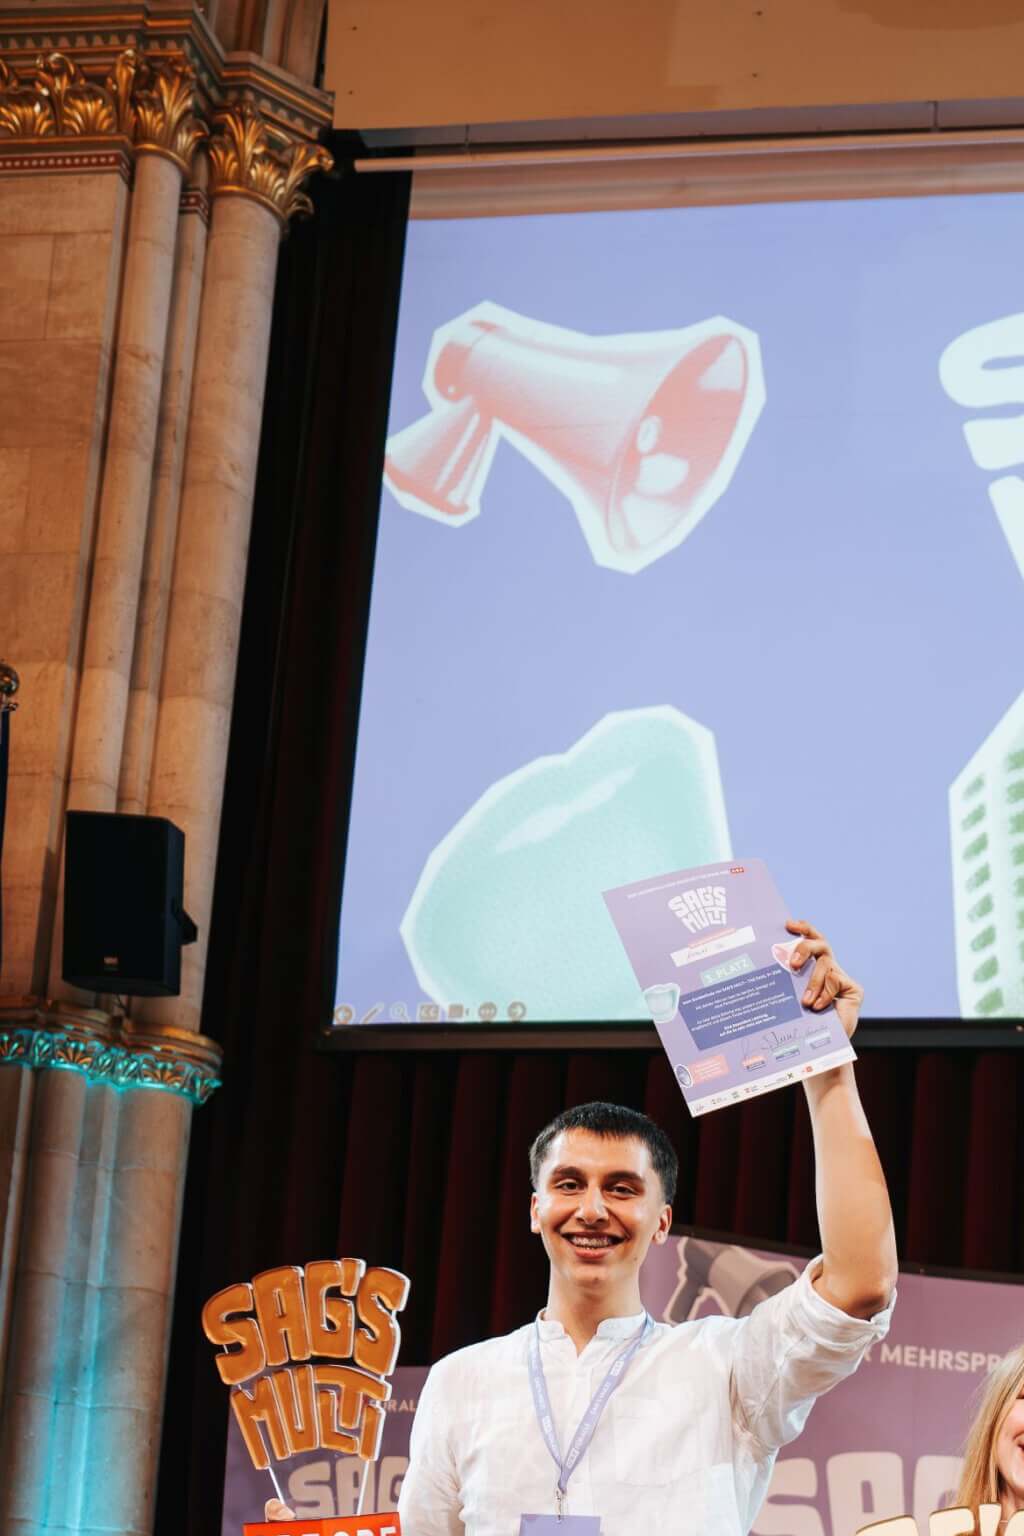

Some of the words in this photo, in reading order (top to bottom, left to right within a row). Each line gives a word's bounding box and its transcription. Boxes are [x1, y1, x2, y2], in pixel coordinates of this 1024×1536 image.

[667, 886, 727, 919] SAG'S
[681, 905, 727, 934] MULTI
[202, 1257, 412, 1385] SAG'S
[231, 1363, 393, 1470] MULTI
